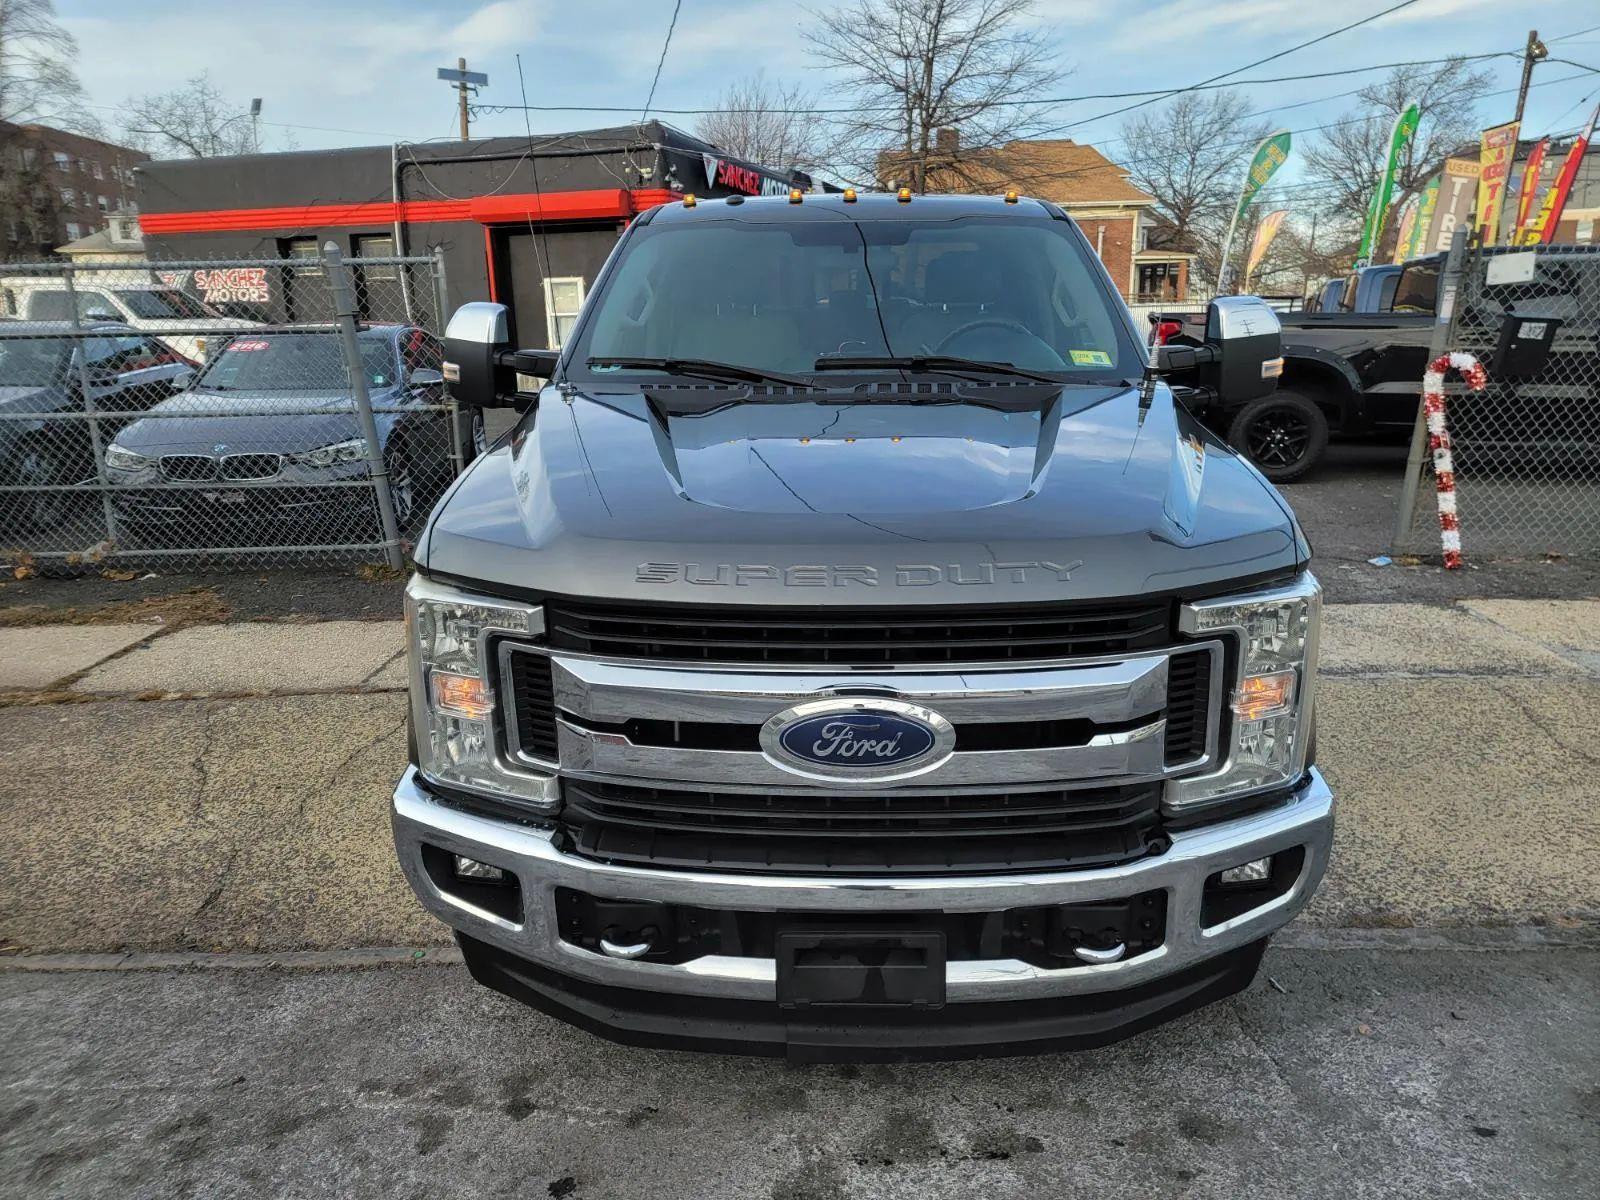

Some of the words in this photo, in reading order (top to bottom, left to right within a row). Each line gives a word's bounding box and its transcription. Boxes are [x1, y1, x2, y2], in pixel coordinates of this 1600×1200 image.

[718, 160, 760, 196] SANCHEZ
[761, 177, 793, 196] MOTO
[1447, 161, 1480, 175] USED
[194, 267, 268, 289] SANCHEZ
[203, 288, 270, 303] MOTORS
[635, 562, 879, 587] SUPER
[895, 560, 1084, 586] DUTY
[812, 721, 903, 757] Ford
